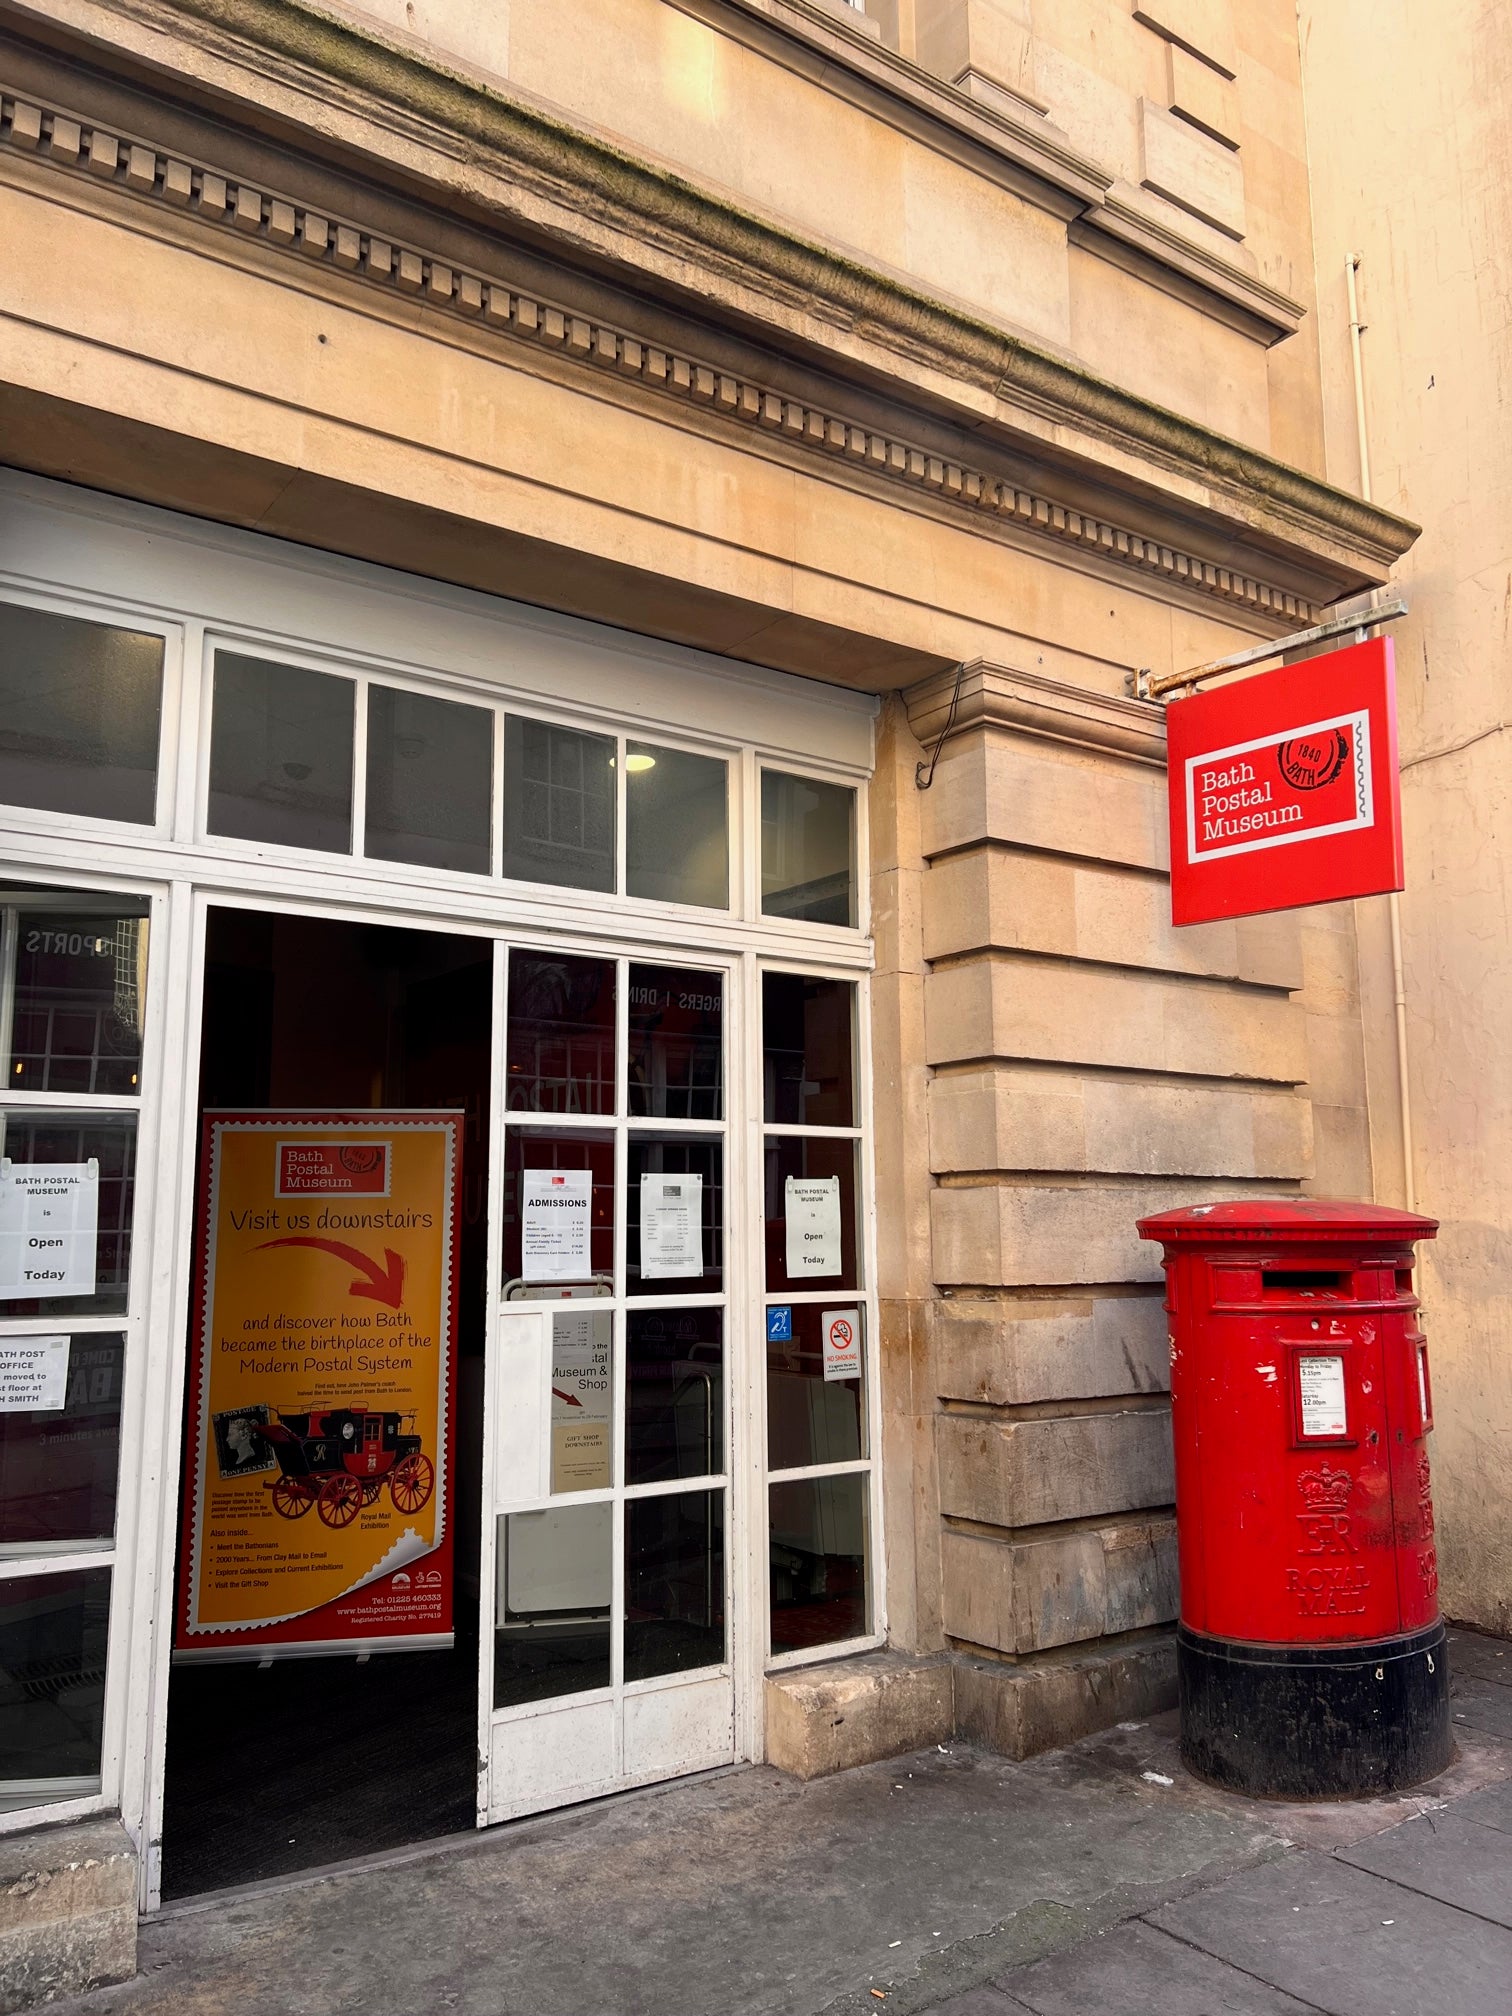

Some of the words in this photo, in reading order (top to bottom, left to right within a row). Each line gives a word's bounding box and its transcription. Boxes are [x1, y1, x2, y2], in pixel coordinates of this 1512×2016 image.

[1297, 743, 1322, 763] 1840
[1201, 762, 1255, 793] Bath
[1286, 761, 1316, 785] BATH
[1202, 781, 1272, 817] Postal
[1203, 804, 1303, 841] Museum
[287, 1151, 323, 1162] Bath
[286, 1164, 334, 1175] Postal
[15, 1177, 41, 1186] BATH
[44, 1177, 81, 1185] POSTAL
[286, 1177, 352, 1188] Museum
[528, 1199, 587, 1208] ADMISSIONS
[43, 1209, 51, 1217] is
[230, 1210, 280, 1231] Visit
[287, 1214, 310, 1229] us
[316, 1208, 433, 1229] downstairs
[804, 1233, 824, 1242] Open
[28, 1238, 64, 1249] Open
[802, 1256, 825, 1265] Today
[24, 1270, 66, 1281] Today
[243, 1314, 269, 1330] and
[274, 1313, 336, 1330] discover
[340, 1313, 371, 1327] how
[376, 1313, 412, 1327] Bath
[221, 1337, 277, 1353] became
[281, 1336, 306, 1350] the
[310, 1335, 384, 1354] birthplace
[388, 1333, 406, 1347] of
[407, 1333, 432, 1347] the
[19, 1350, 46, 1359] POST
[0, 1361, 34, 1370] OFFICE
[240, 1358, 299, 1374] Modern
[303, 1357, 353, 1373] Postal
[357, 1356, 413, 1374] System
[3, 1373, 36, 1381] moved
[37, 1372, 47, 1380] to
[552, 1366, 597, 1378] Museum
[599, 1366, 608, 1376] &
[8, 1384, 30, 1392] floor
[578, 1379, 608, 1391] Shop
[8, 1394, 40, 1403] SMITH
[223, 1406, 257, 1418] POSTAGE
[39, 1433, 47, 1446] 3
[49, 1430, 93, 1445] minutes
[567, 1434, 581, 1442] GIFT
[583, 1433, 600, 1442] SHOP
[564, 1441, 603, 1449] DOWNSTAIRS
[243, 1463, 267, 1473] PENNY
[360, 1513, 377, 1522] Royal
[378, 1512, 392, 1520] Mail
[360, 1521, 390, 1530] Exhibition
[210, 1529, 225, 1538] Also
[217, 1543, 231, 1551] Meet
[233, 1542, 243, 1550] the
[244, 1541, 279, 1550] Bathonians
[216, 1555, 231, 1564] 2000
[256, 1553, 272, 1562] From
[273, 1553, 287, 1562] Clay
[288, 1552, 301, 1561] Mail
[302, 1552, 309, 1560] to
[310, 1551, 327, 1560] Email
[215, 1568, 238, 1578] Explore
[239, 1566, 273, 1576] Collections
[274, 1565, 286, 1574] and
[286, 1564, 310, 1573] Current
[311, 1563, 343, 1571] Exhibitions
[215, 1580, 229, 1589] Visit
[230, 1579, 240, 1588] the
[241, 1579, 252, 1588] Gift
[253, 1578, 269, 1588] Shop
[1286, 1565, 1371, 1591] ROYAL
[371, 1597, 386, 1605] Tel:
[412, 1594, 442, 1602] 460333
[1297, 1591, 1366, 1616] MAIL
[337, 1603, 442, 1615] www.bathpostalmuseum.org
[351, 1615, 384, 1624] Registered
[384, 1614, 407, 1623] Charity
